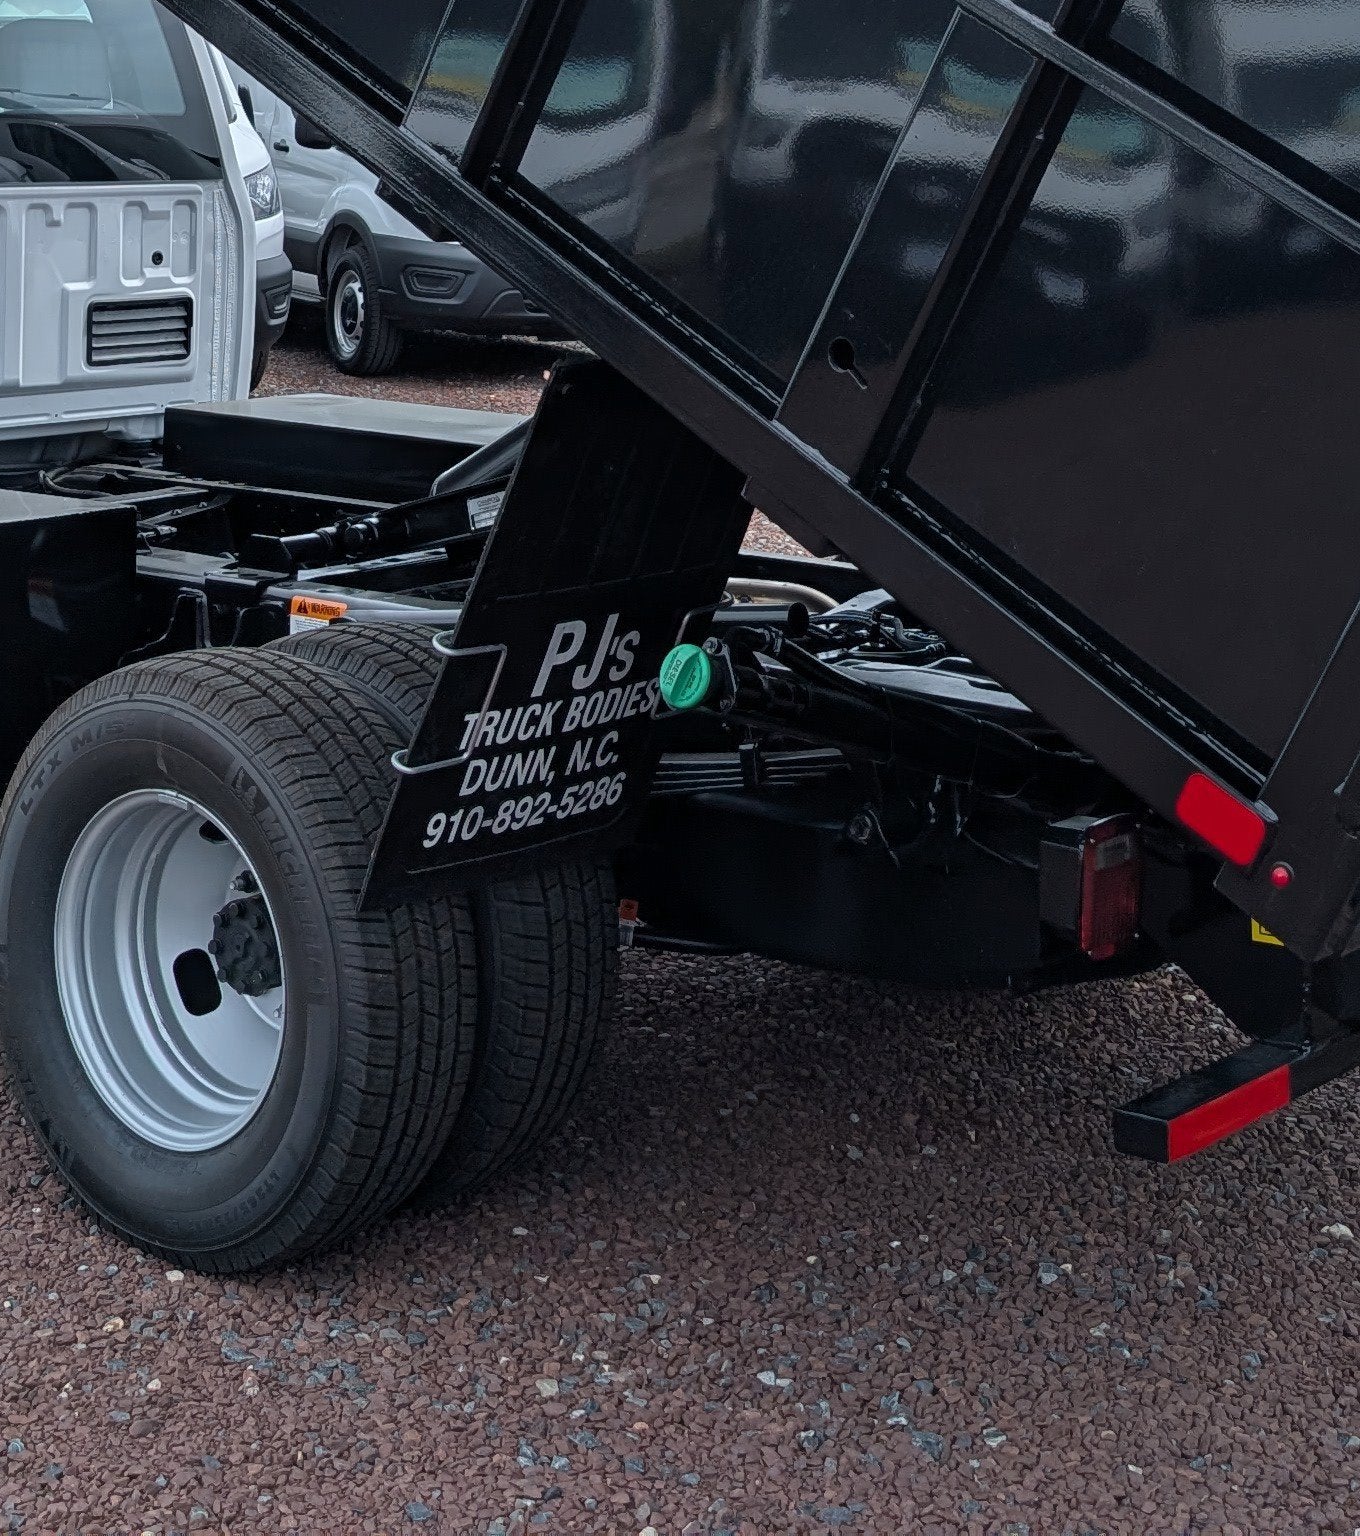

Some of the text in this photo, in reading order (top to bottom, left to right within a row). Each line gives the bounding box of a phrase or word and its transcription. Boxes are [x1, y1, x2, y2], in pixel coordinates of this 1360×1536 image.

[311, 603, 341, 616] WARNING
[530, 613, 640, 698] PJ's
[666, 659, 683, 686] DIESEL
[458, 700, 563, 752] TRUCK
[562, 677, 659, 733] BODIES
[20, 751, 63, 816] LTX
[458, 731, 619, 797] DUNN, N.C.
[422, 772, 627, 849] 910-892-5286
